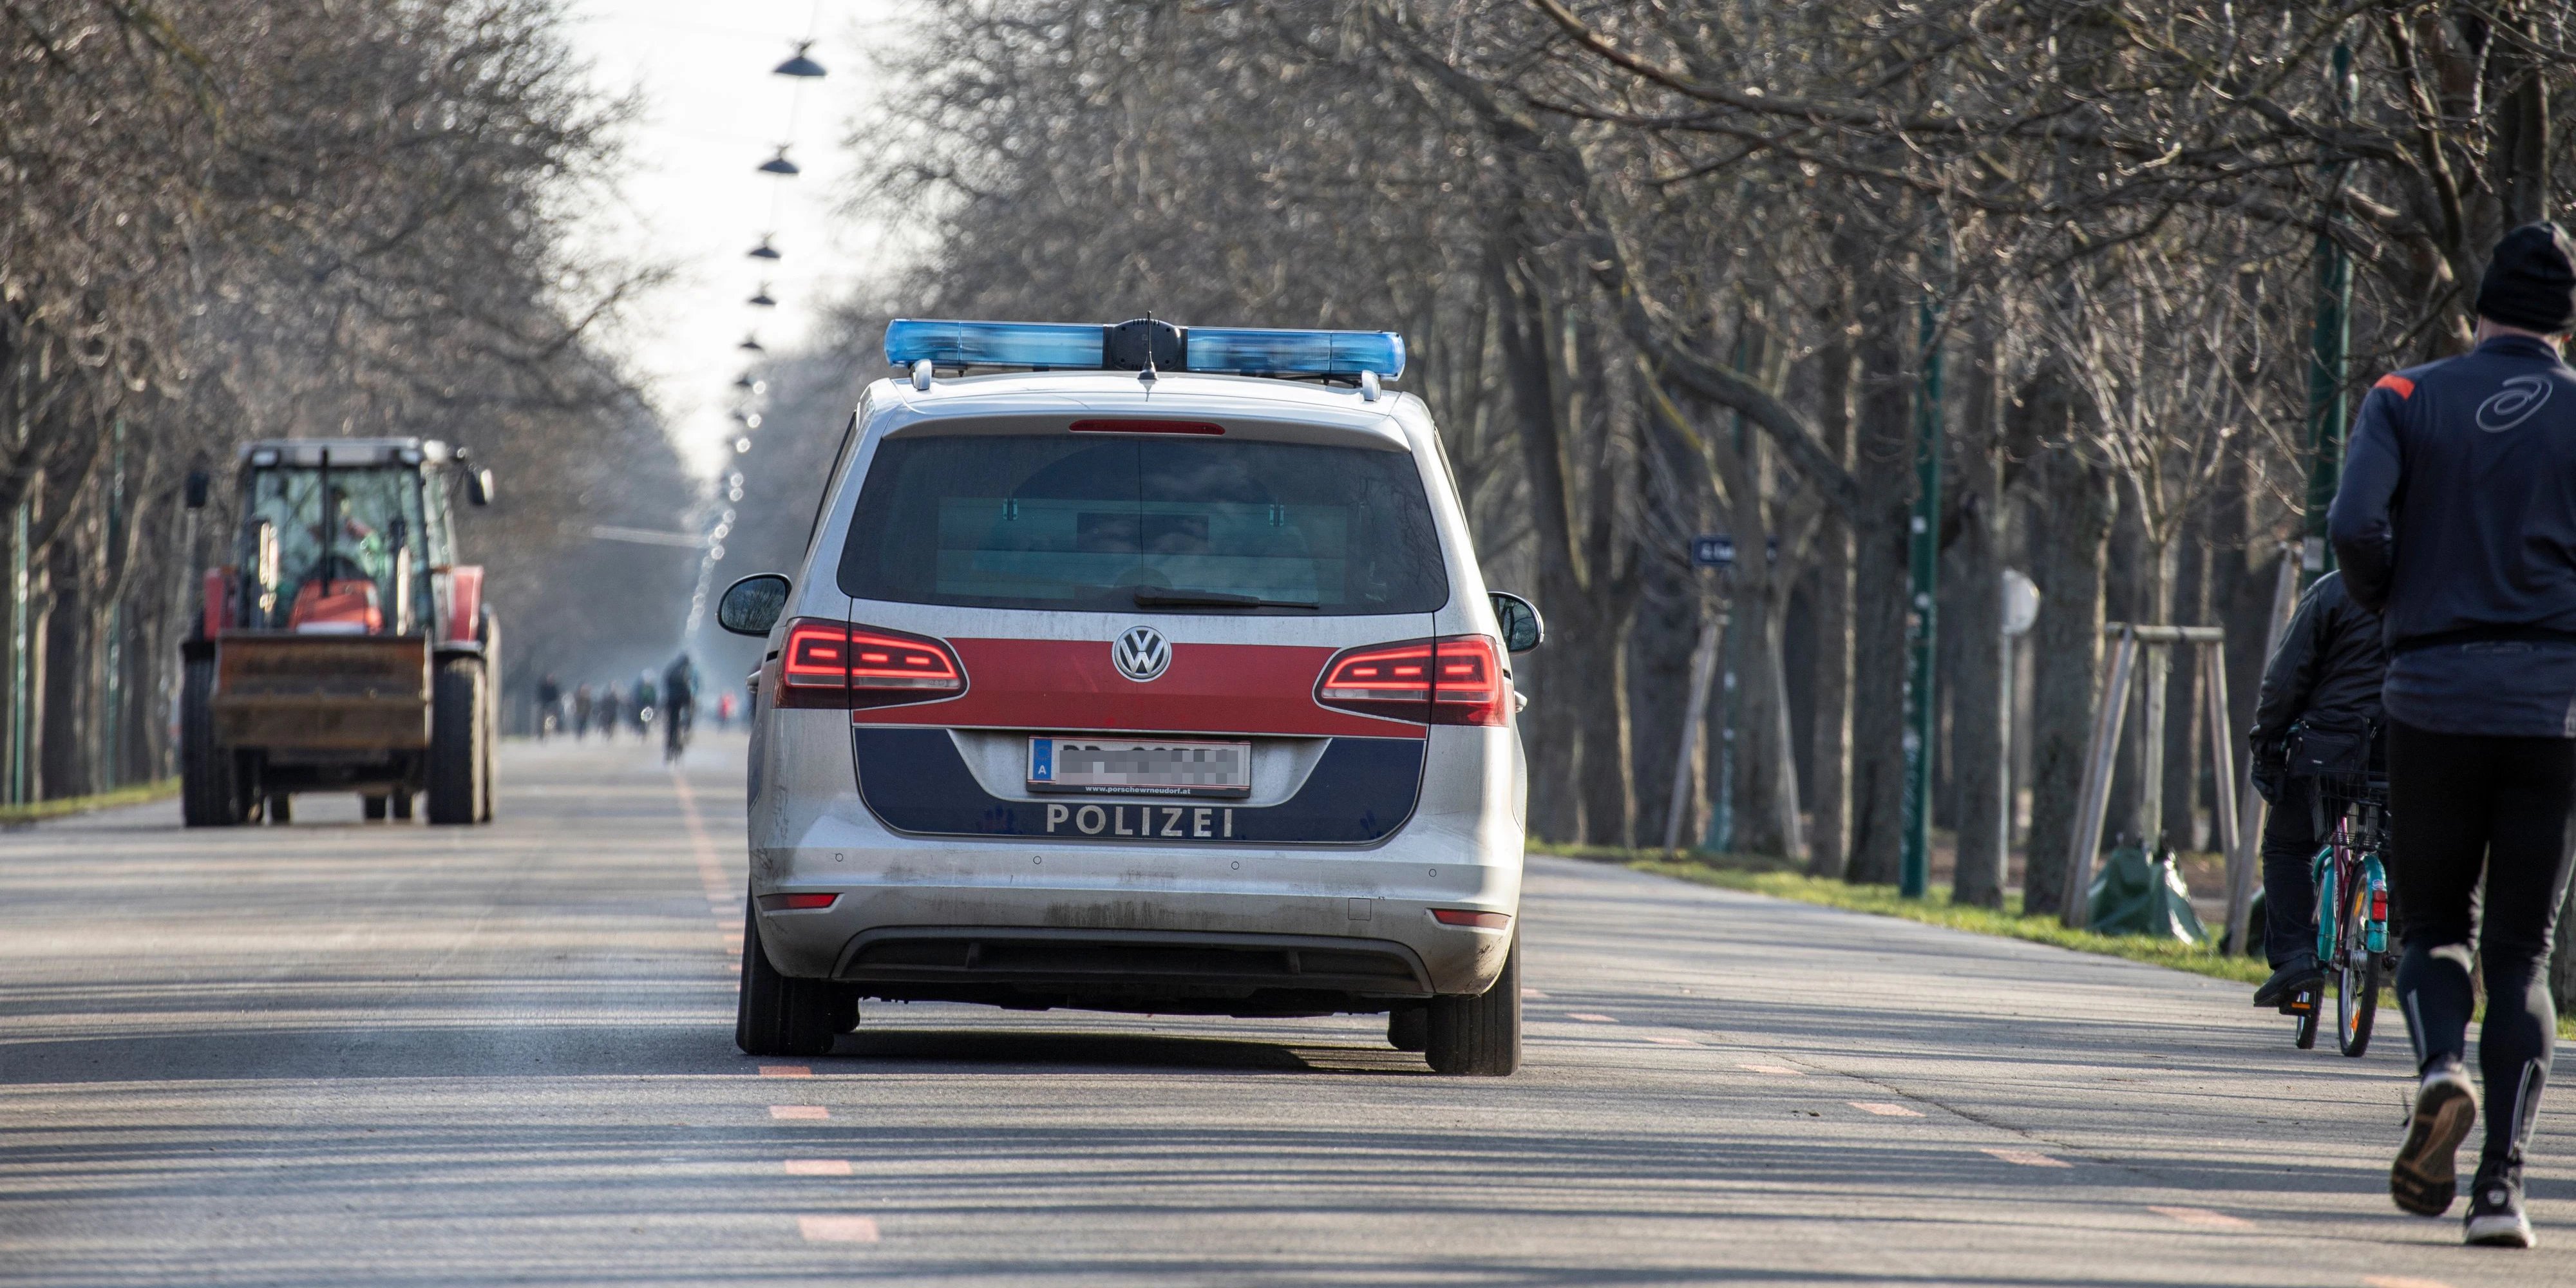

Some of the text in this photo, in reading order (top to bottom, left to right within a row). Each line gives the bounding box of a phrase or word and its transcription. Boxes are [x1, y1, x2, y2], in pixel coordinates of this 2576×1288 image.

[1117, 629, 1167, 676] VW
[1038, 764, 1046, 774] A
[1085, 786, 1191, 795] www.porschewrneudorf.at
[1046, 804, 1232, 837] POLIZEI
